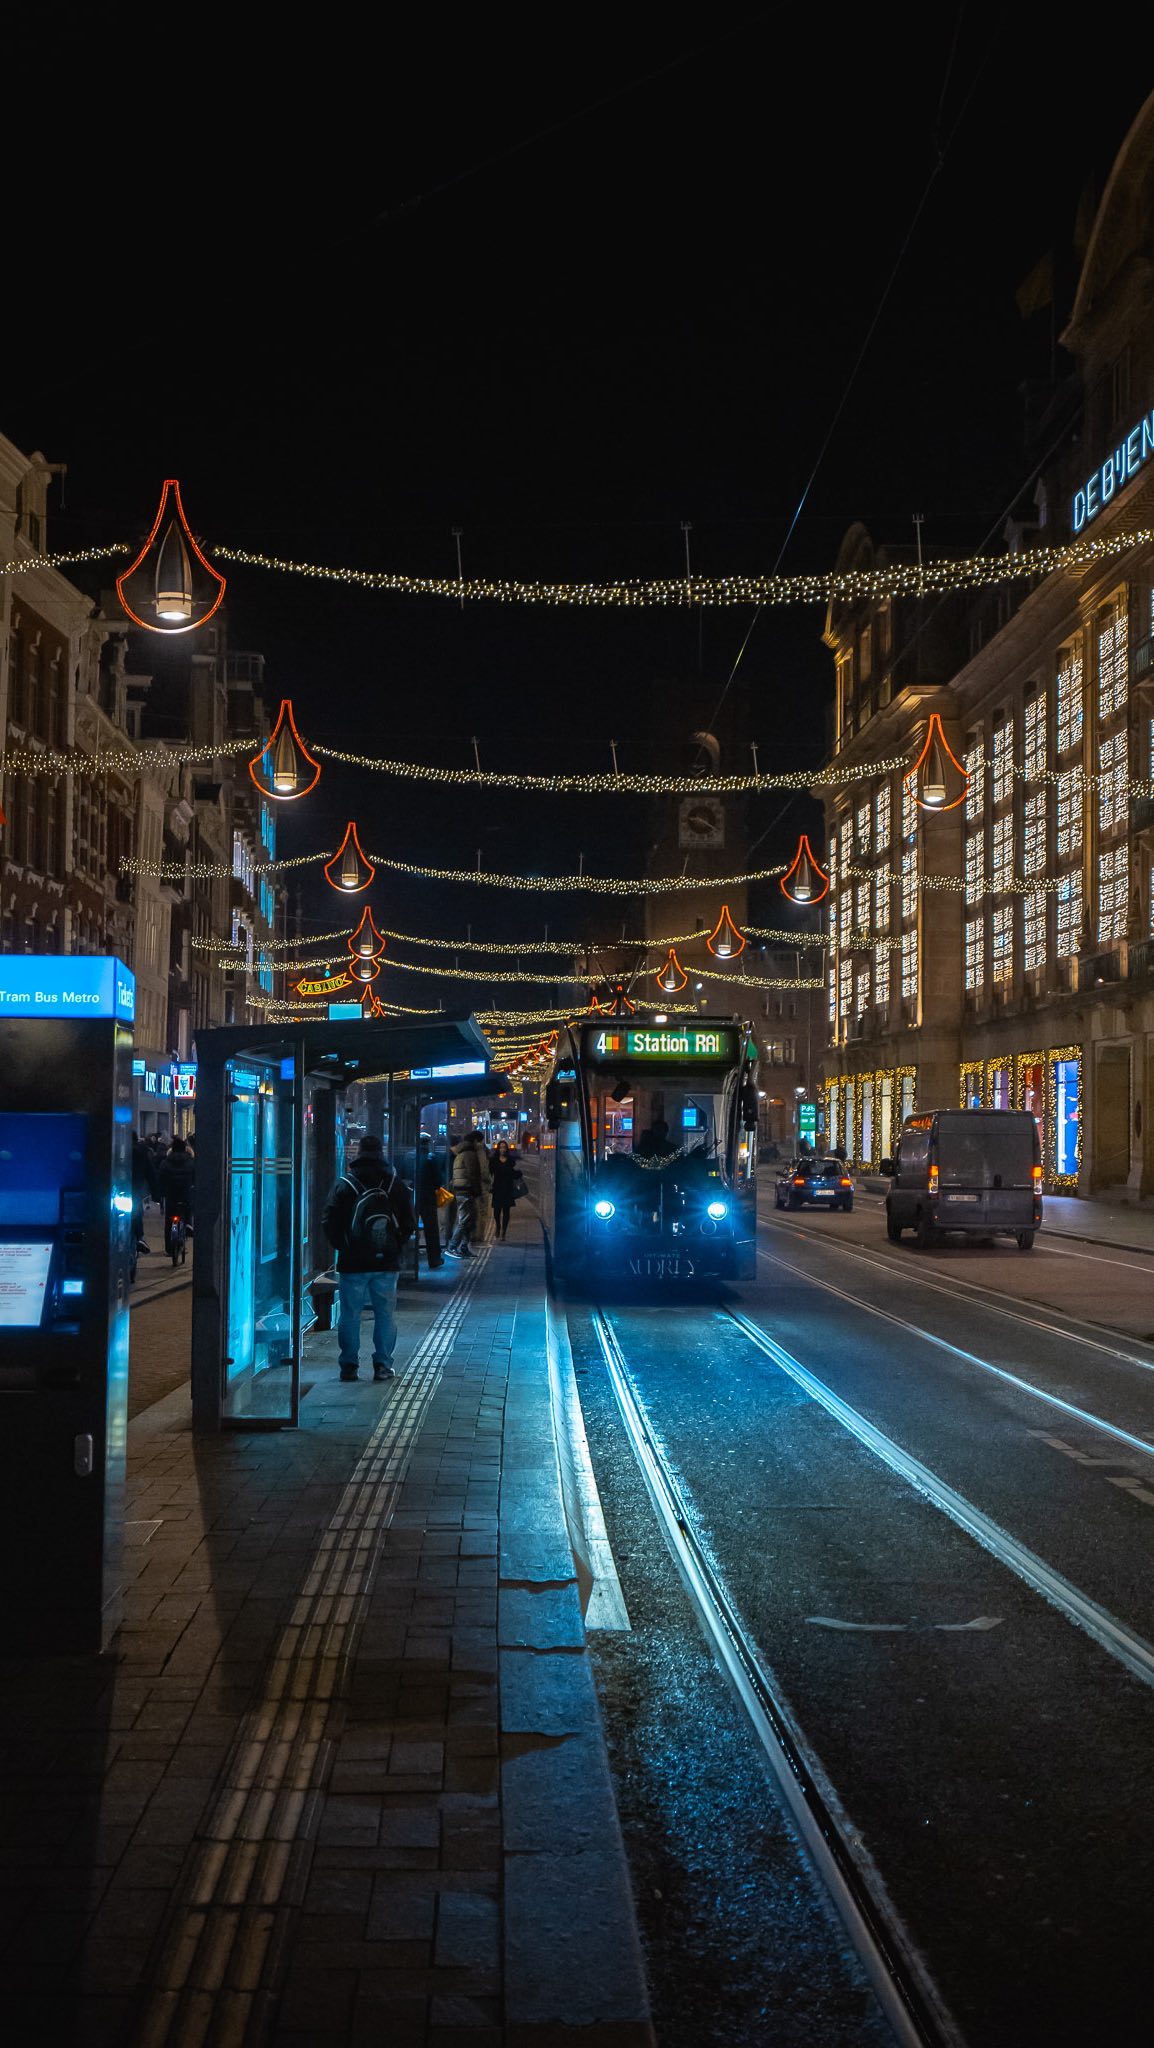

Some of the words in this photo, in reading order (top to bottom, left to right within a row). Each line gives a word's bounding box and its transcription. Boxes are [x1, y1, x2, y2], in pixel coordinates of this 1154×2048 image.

[1073, 473, 1099, 531] DE
[299, 978, 344, 992] CASINO
[0, 991, 31, 1003] Tram
[35, 991, 58, 1003] Bus
[63, 991, 100, 1004] Metro
[597, 1033, 607, 1054] 4
[634, 1033, 689, 1053] Station
[696, 1034, 719, 1053] RAI
